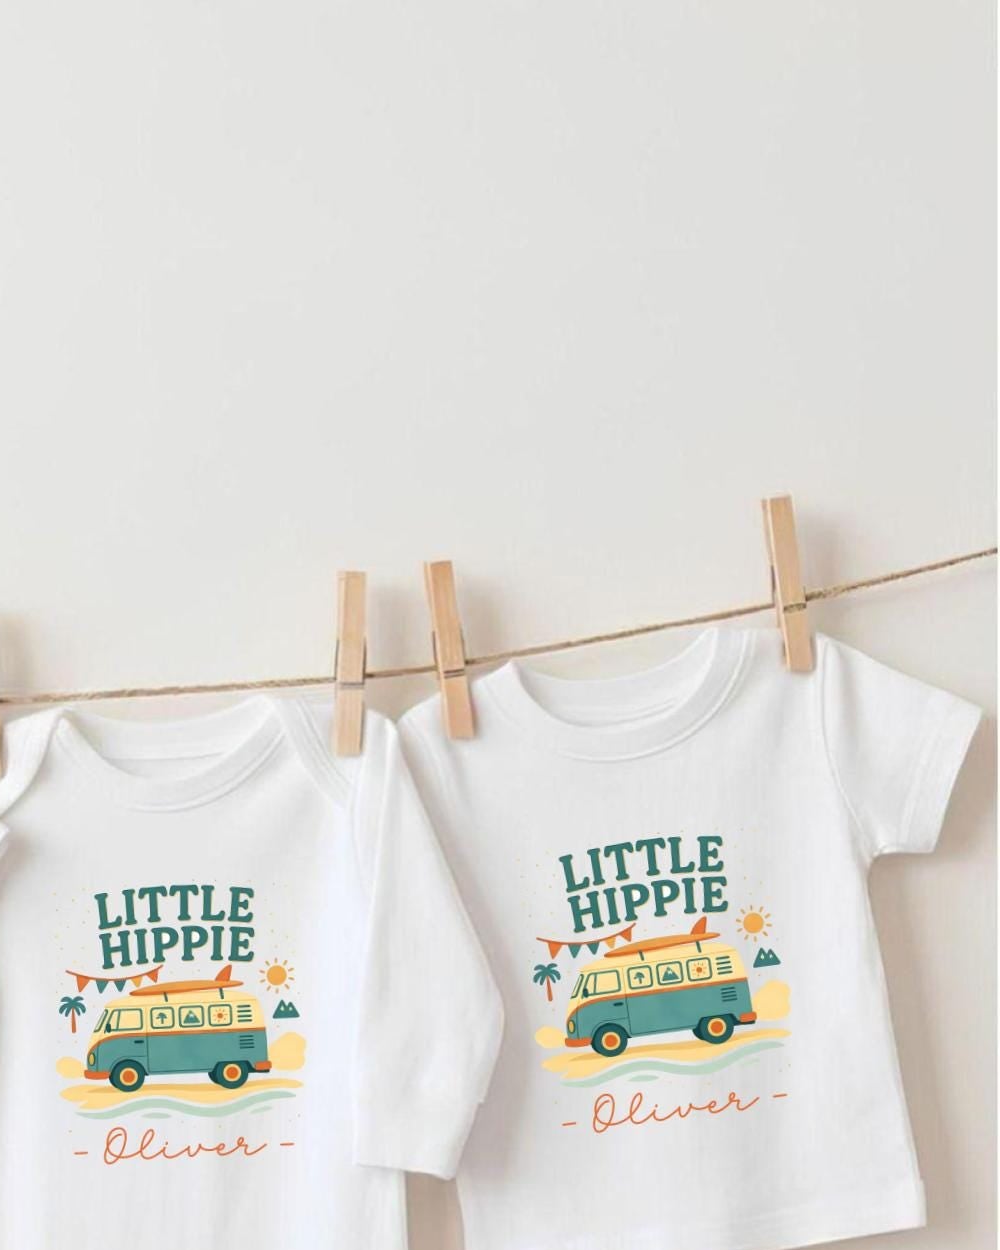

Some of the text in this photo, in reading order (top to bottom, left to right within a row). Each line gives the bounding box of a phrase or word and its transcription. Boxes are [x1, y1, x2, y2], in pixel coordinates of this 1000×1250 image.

[559, 835, 724, 893] LITTLE
[94, 884, 255, 929] LITTLE
[567, 876, 729, 933] HIPPIE
[99, 925, 255, 969] HIPPIE
[592, 1092, 760, 1133] Oliver
[104, 1127, 267, 1165] Oliver
